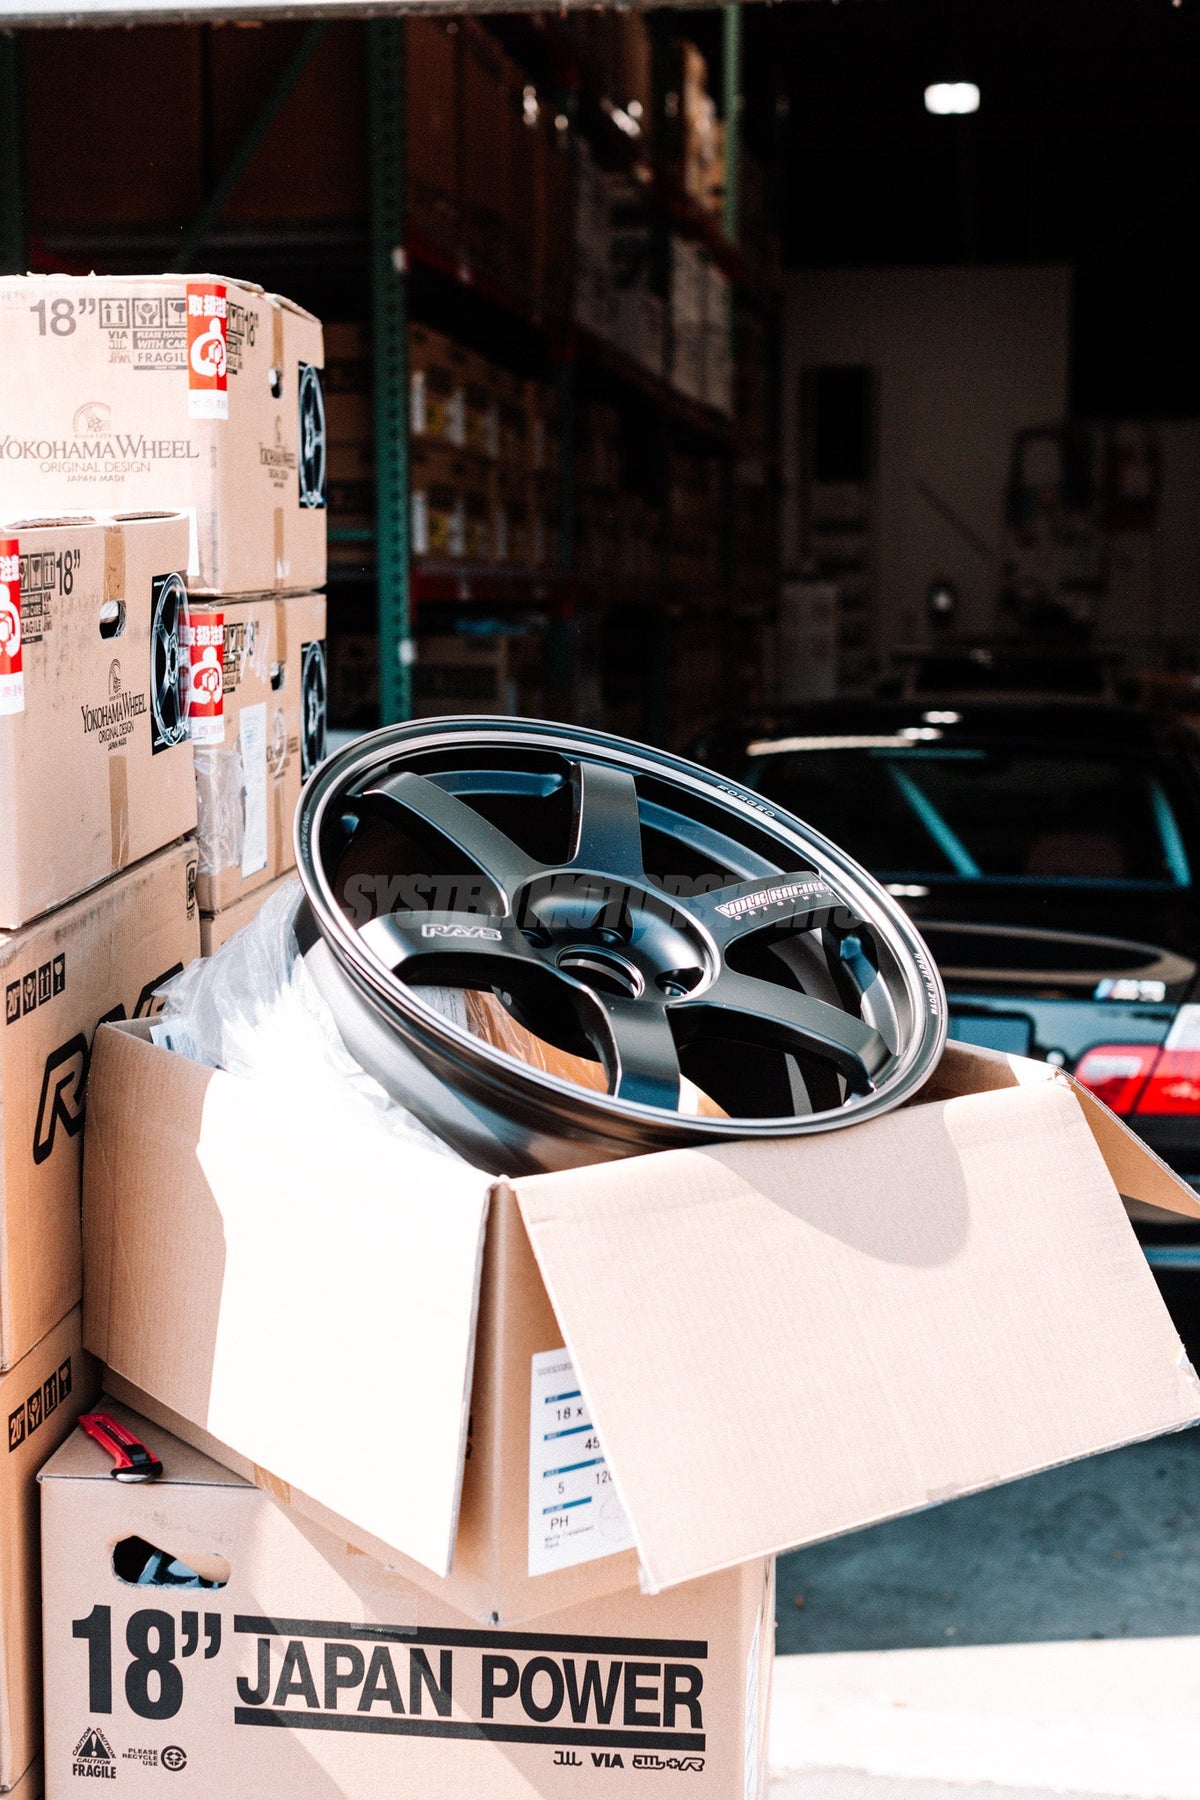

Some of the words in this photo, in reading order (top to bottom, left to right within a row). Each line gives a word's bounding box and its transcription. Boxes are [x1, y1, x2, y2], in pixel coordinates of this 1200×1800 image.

[108, 330, 128, 339] VIA
[136, 331, 162, 339] PLEASE
[137, 339, 164, 349] WITH
[165, 339, 187, 349] CAR
[137, 352, 186, 362] FRAGIL
[39, 461, 100, 473] ORIGINAL
[104, 461, 151, 473] DESIGN
[98, 726, 119, 744] ORIGINAL
[119, 720, 134, 737] DESIGN
[717, 784, 775, 818] FORGED
[421, 923, 503, 942] RAYS
[913, 952, 932, 981] JAPAN
[557, 1407, 571, 1420] 18
[585, 1436, 601, 1450] 45
[558, 1480, 565, 1495] 5
[550, 1515, 569, 1530] PH
[235, 1638, 452, 1717] JAPAN
[481, 1655, 705, 1730] POWER
[72, 1726, 92, 1757] CAUTION
[95, 1727, 117, 1759] CAUTION
[122, 1753, 158, 1761] RECYCLE
[128, 1747, 158, 1756] PLEASE
[76, 1757, 111, 1766] CAUTION
[590, 1752, 625, 1769] VIA
[72, 1763, 117, 1779] FRAGILE
